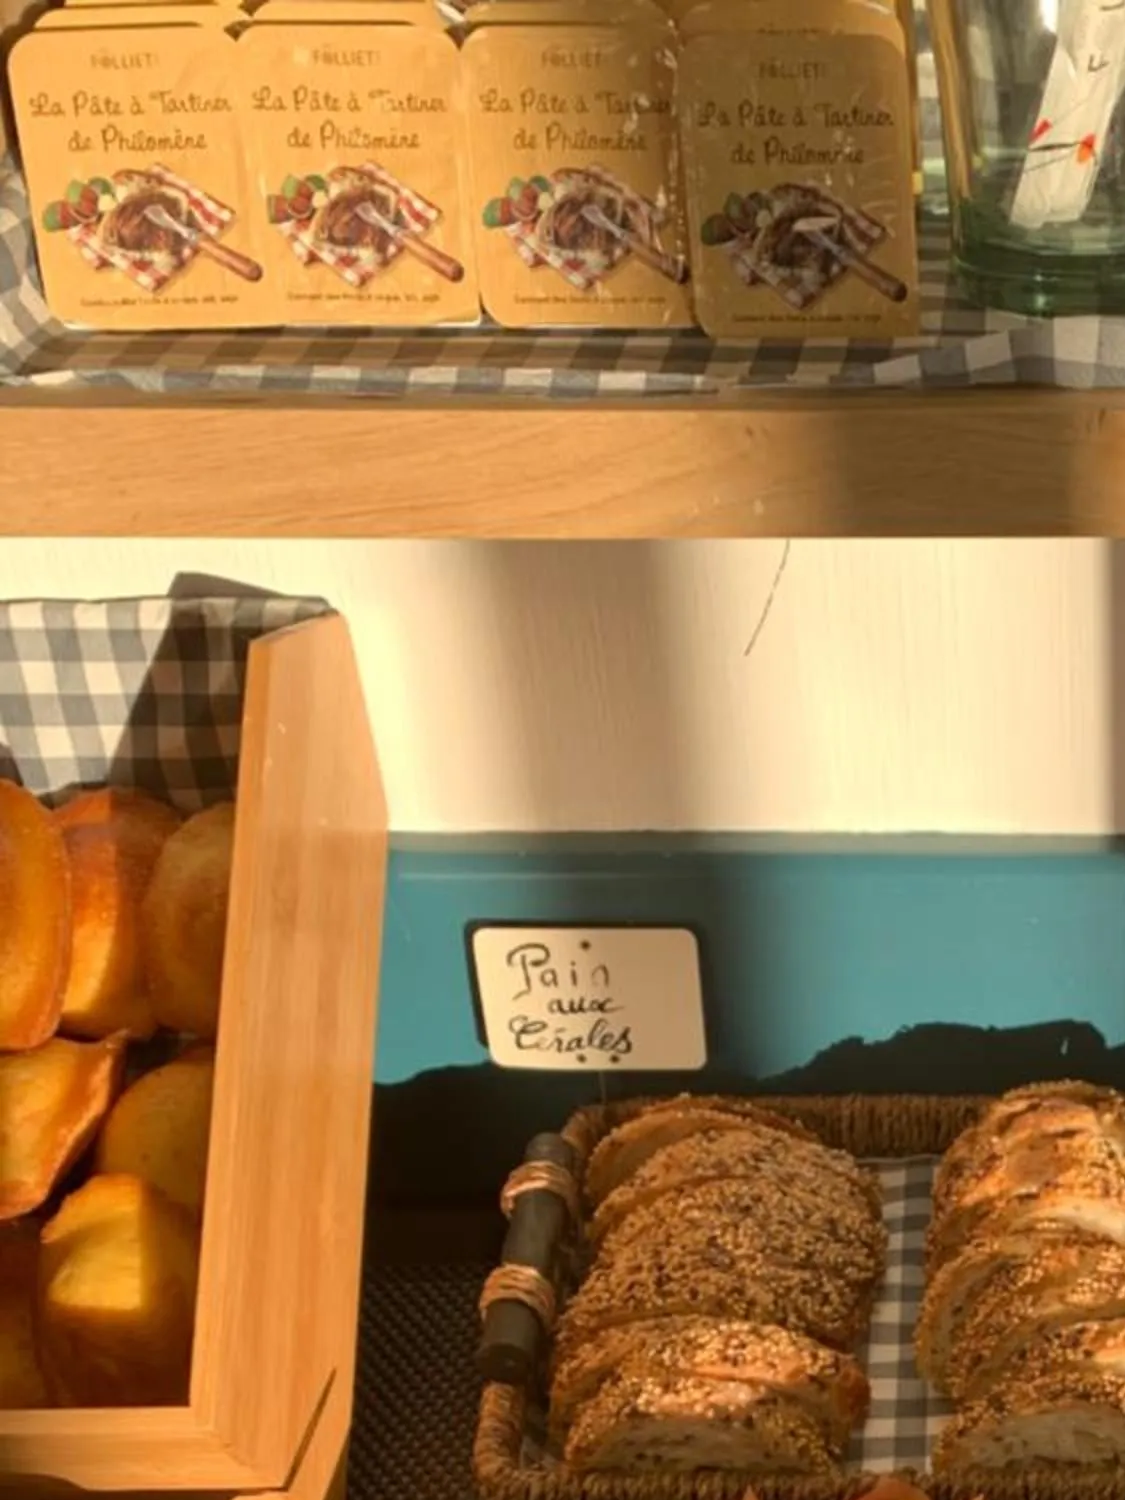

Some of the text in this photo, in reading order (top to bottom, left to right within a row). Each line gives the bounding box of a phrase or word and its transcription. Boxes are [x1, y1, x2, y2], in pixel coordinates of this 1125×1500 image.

[30, 90, 232, 116] La Pâte à Tartiner
[252, 85, 287, 111] La
[293, 85, 341, 111] Pâte
[347, 92, 361, 111] à
[480, 88, 513, 113] La
[521, 87, 568, 114] Pâte
[697, 101, 731, 127] La
[738, 98, 786, 128] Pâte
[68, 130, 92, 151] de
[287, 127, 311, 148] de
[514, 128, 536, 149] de
[732, 142, 755, 164] de
[506, 942, 610, 1001] Pain
[547, 996, 624, 1015] aux
